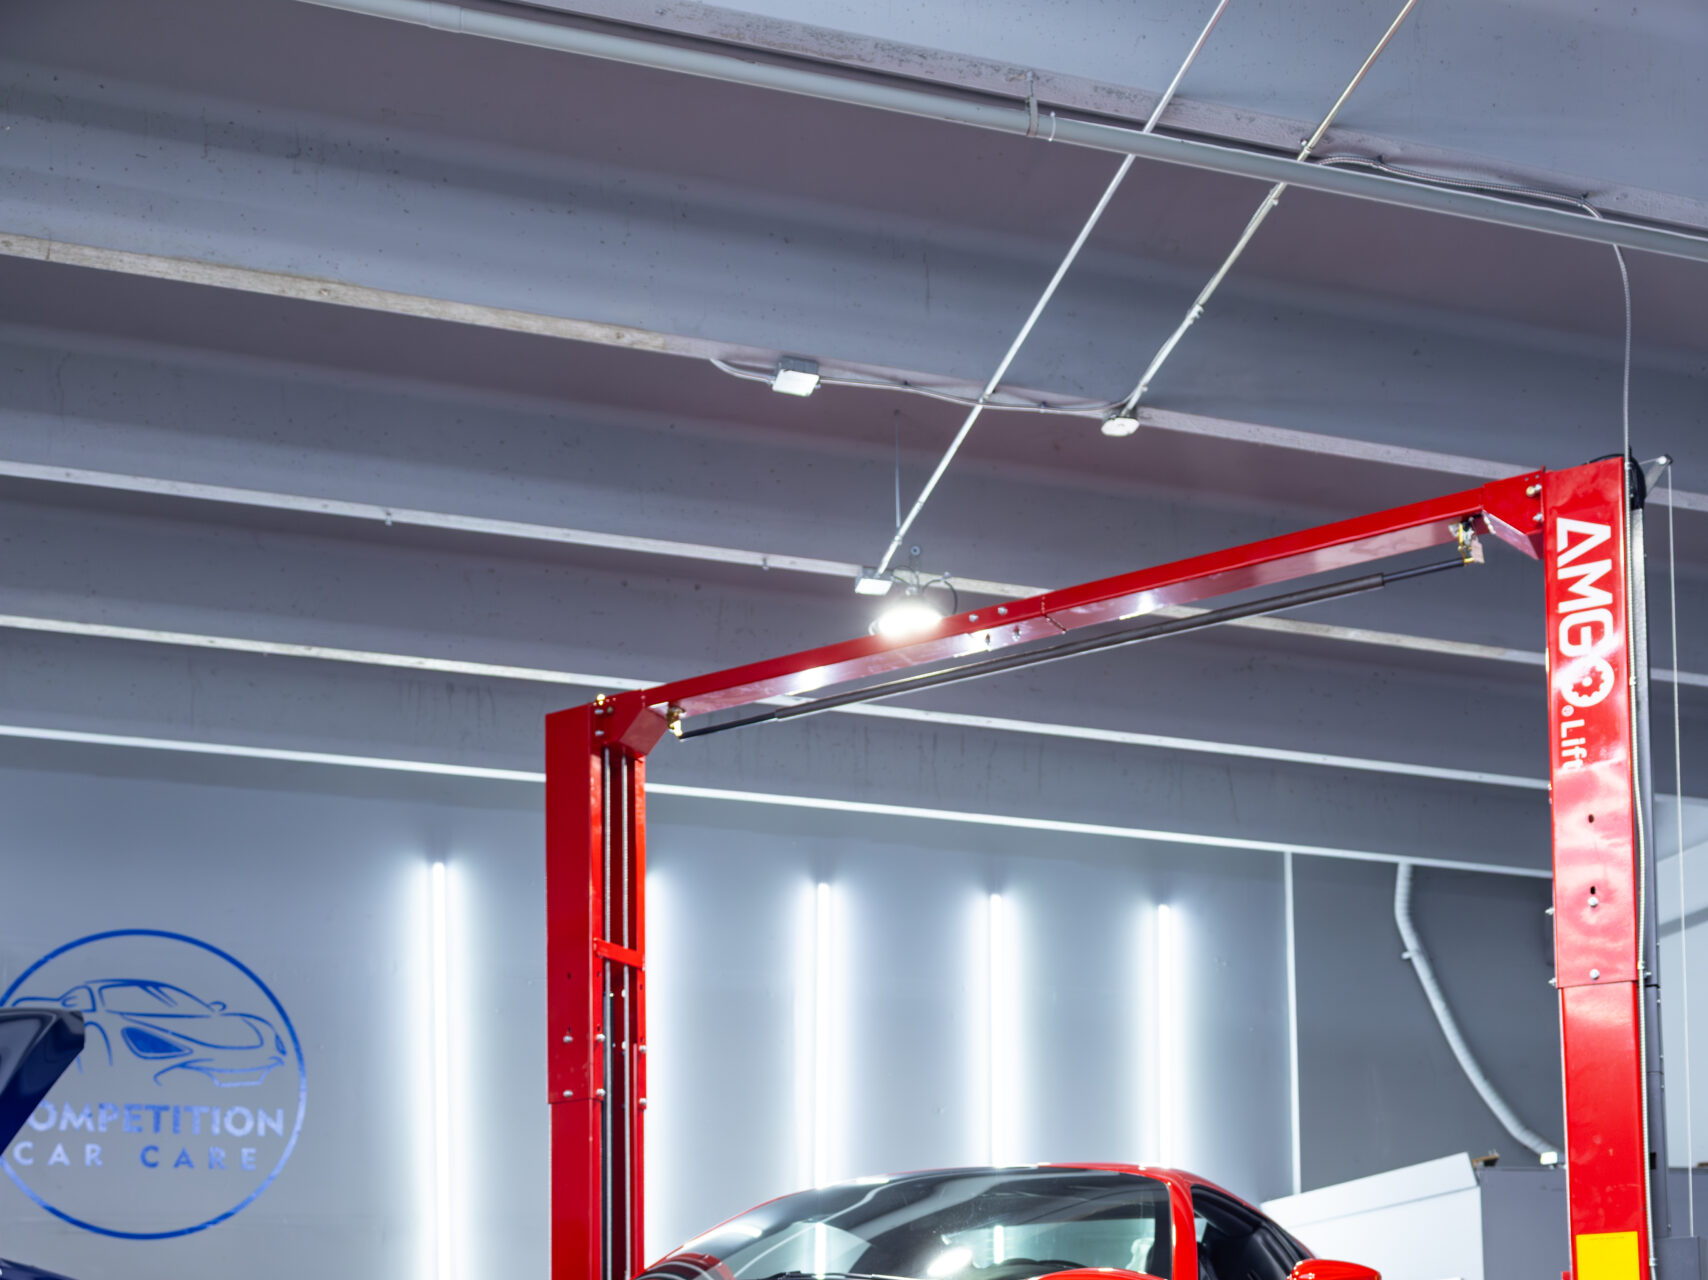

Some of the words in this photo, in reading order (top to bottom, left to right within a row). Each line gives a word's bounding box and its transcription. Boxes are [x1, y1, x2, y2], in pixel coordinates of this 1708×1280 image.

[1560, 719, 1588, 772] Lift
[28, 1100, 285, 1137] OMPETITION
[12, 1140, 104, 1167] CAR
[139, 1145, 257, 1170] CARE
